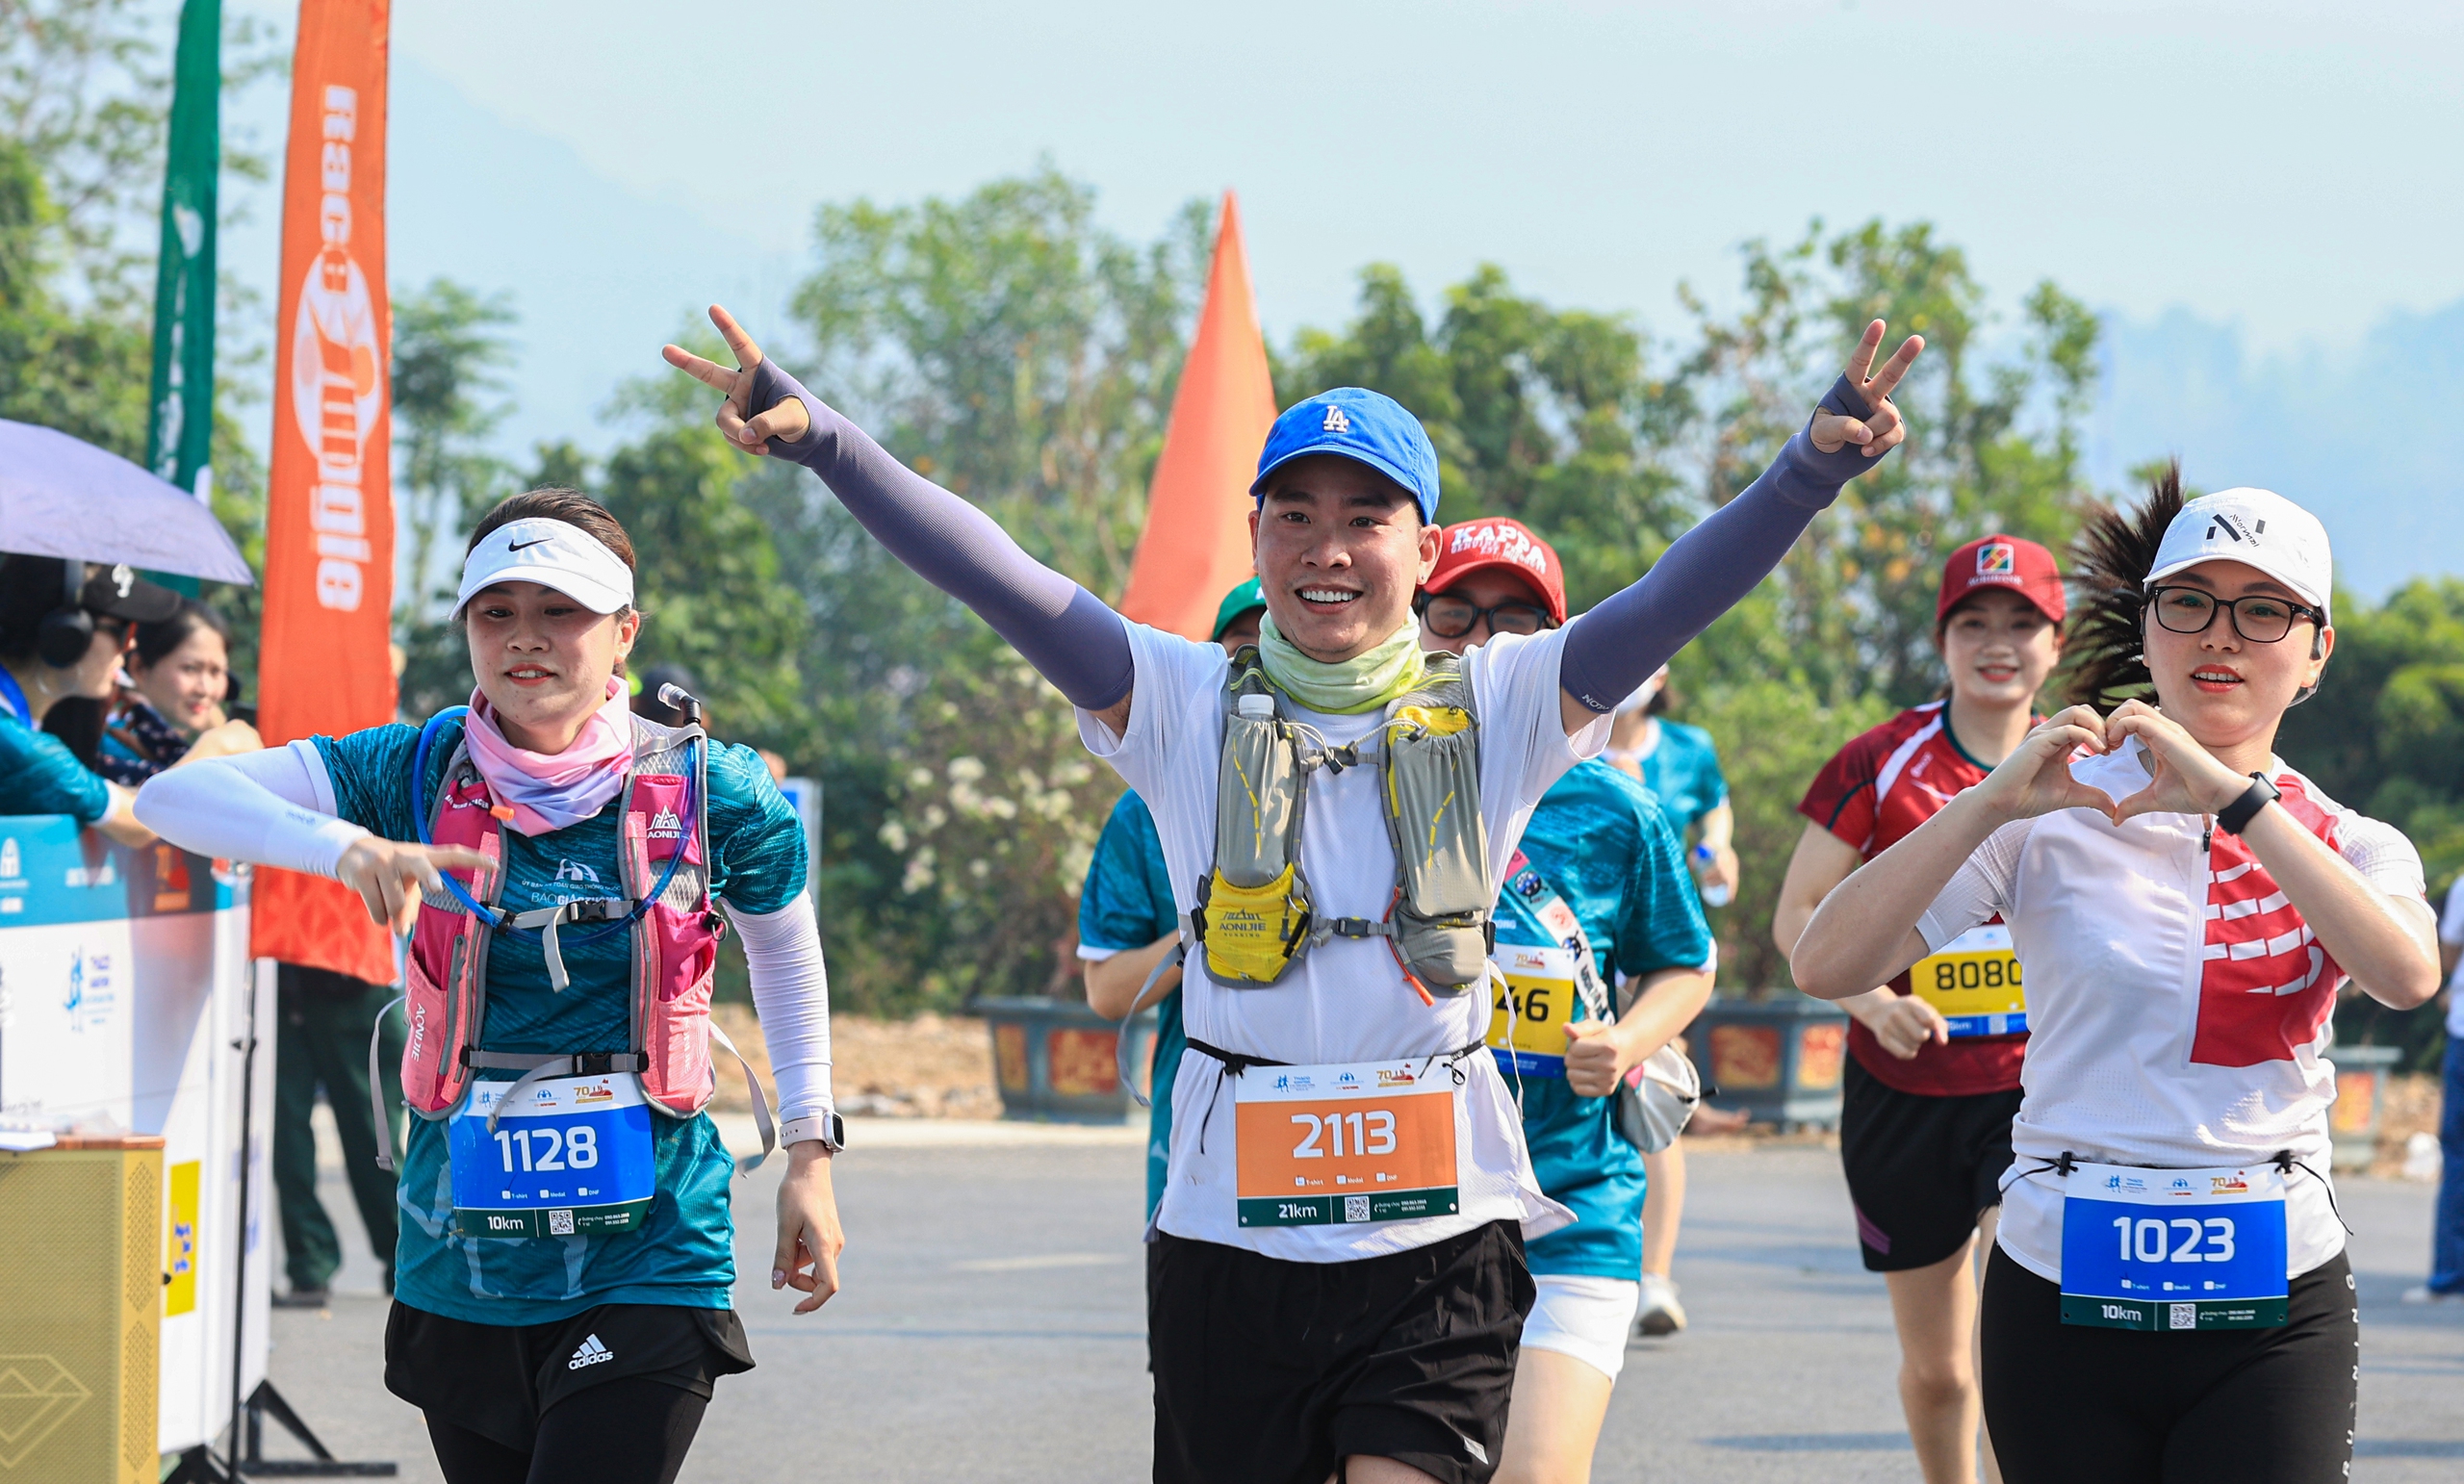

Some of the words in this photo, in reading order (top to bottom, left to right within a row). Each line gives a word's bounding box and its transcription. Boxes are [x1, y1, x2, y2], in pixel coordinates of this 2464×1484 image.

[321, 84, 357, 292] Race
[1323, 405, 1348, 433] LA
[1451, 525, 1546, 575] KAPPA
[647, 831, 680, 839] AONIJI
[1219, 922, 1267, 932] AONIJIE
[411, 1003, 426, 1062] AONIJIE
[1376, 1069, 1392, 1081] 70
[574, 1087, 590, 1096] 70
[1291, 1111, 1397, 1159] 2113
[494, 1125, 599, 1172] 1128
[2210, 1177, 2226, 1188] 70
[1278, 1203, 1318, 1219] 21km
[487, 1215, 524, 1231] 10km
[2113, 1216, 2235, 1264] 1023
[2101, 1304, 2142, 1322] 10km
[569, 1351, 614, 1370] adidas
